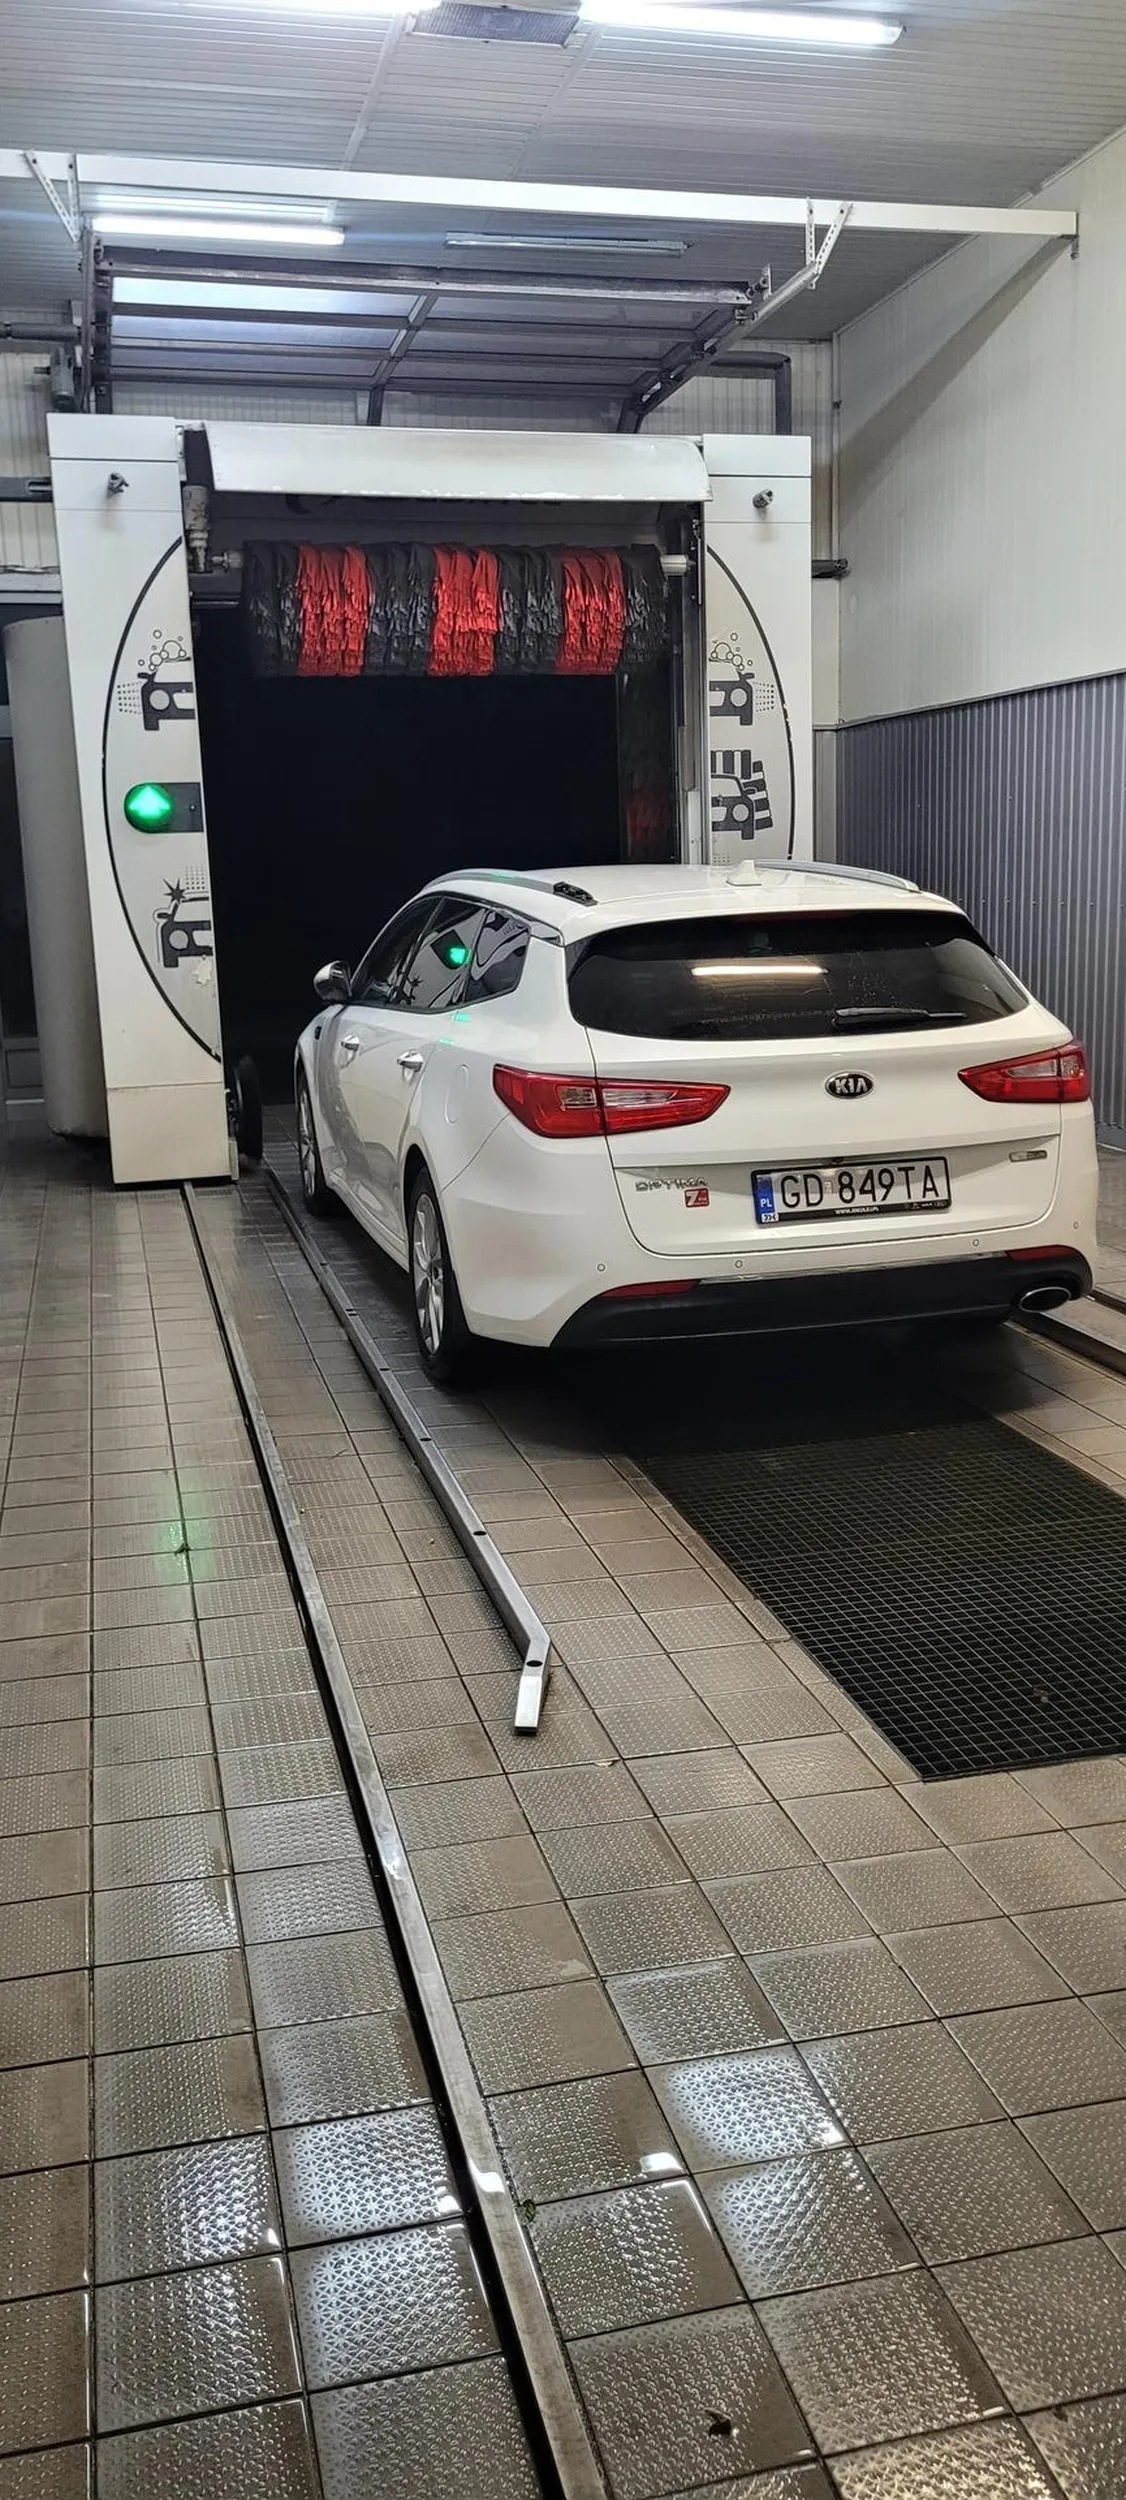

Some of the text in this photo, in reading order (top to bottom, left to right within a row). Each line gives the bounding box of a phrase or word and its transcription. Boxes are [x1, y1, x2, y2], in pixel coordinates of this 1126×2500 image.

[834, 1077, 868, 1094] KIA
[780, 1165, 939, 1209] GD 849TA
[760, 1198, 773, 1208] PL
